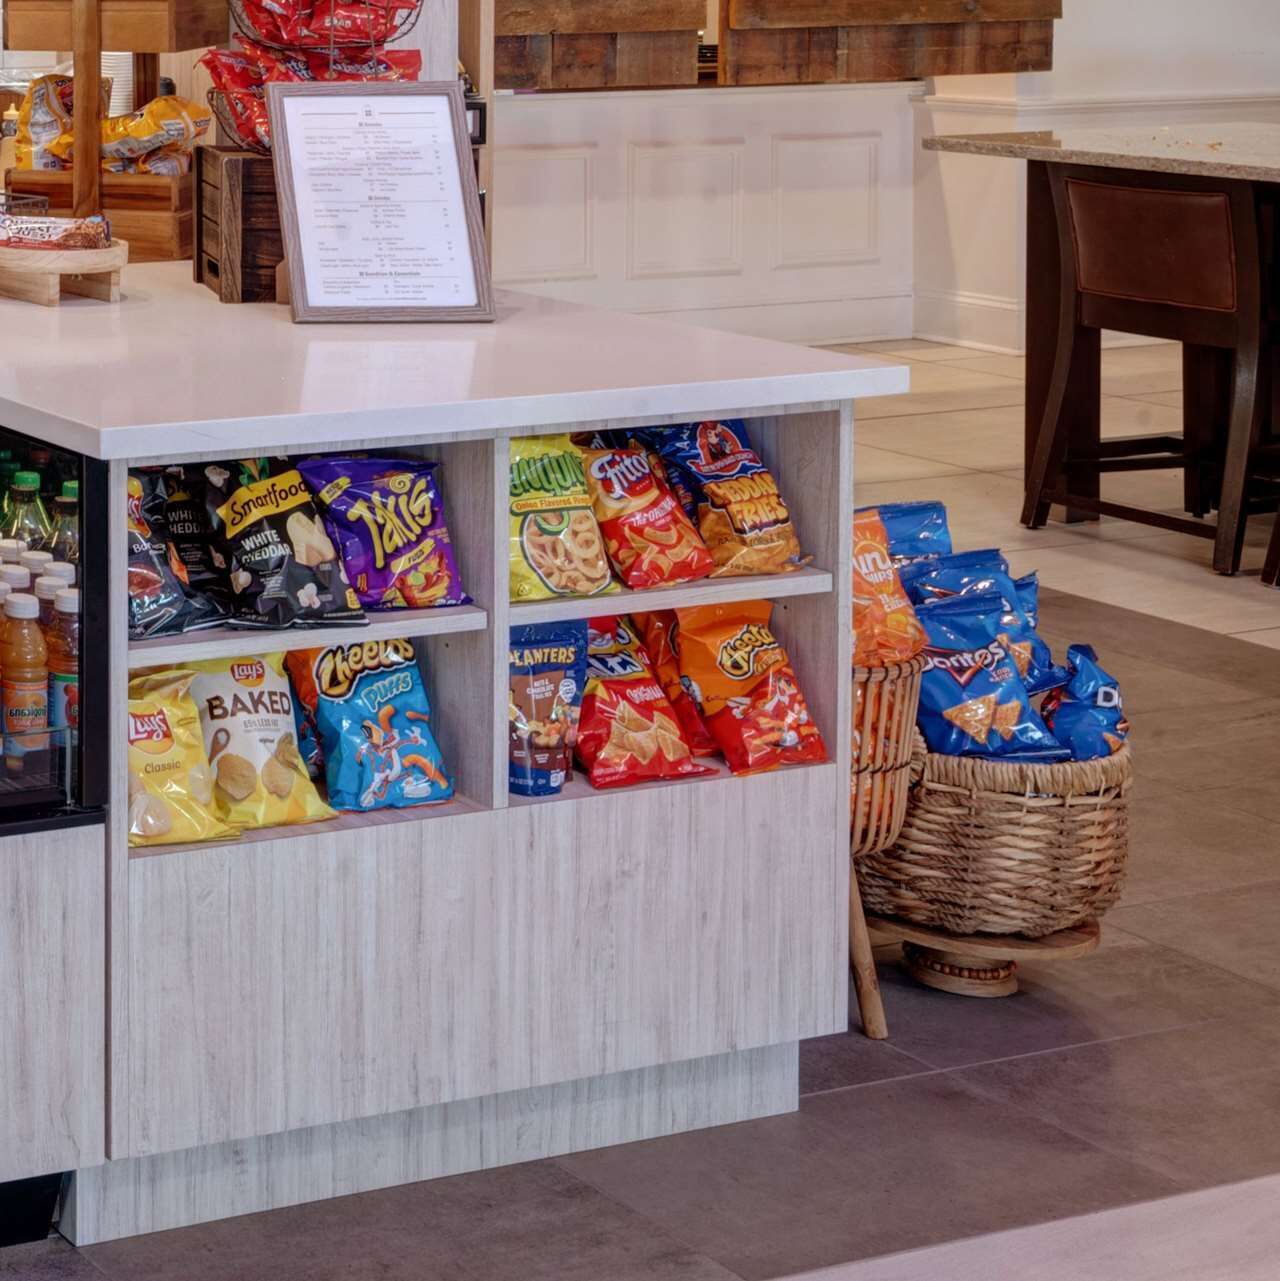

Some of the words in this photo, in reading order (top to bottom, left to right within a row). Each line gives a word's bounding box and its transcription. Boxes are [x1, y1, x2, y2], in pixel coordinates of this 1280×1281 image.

[591, 451, 650, 500] Frito
[540, 497, 573, 509] Flavored
[241, 529, 280, 551] WHITE
[718, 624, 777, 677] Cheeto
[233, 660, 266, 681] Lay's
[206, 690, 292, 721] BAKED
[128, 706, 170, 742] Lay's
[144, 759, 182, 774] Classic
